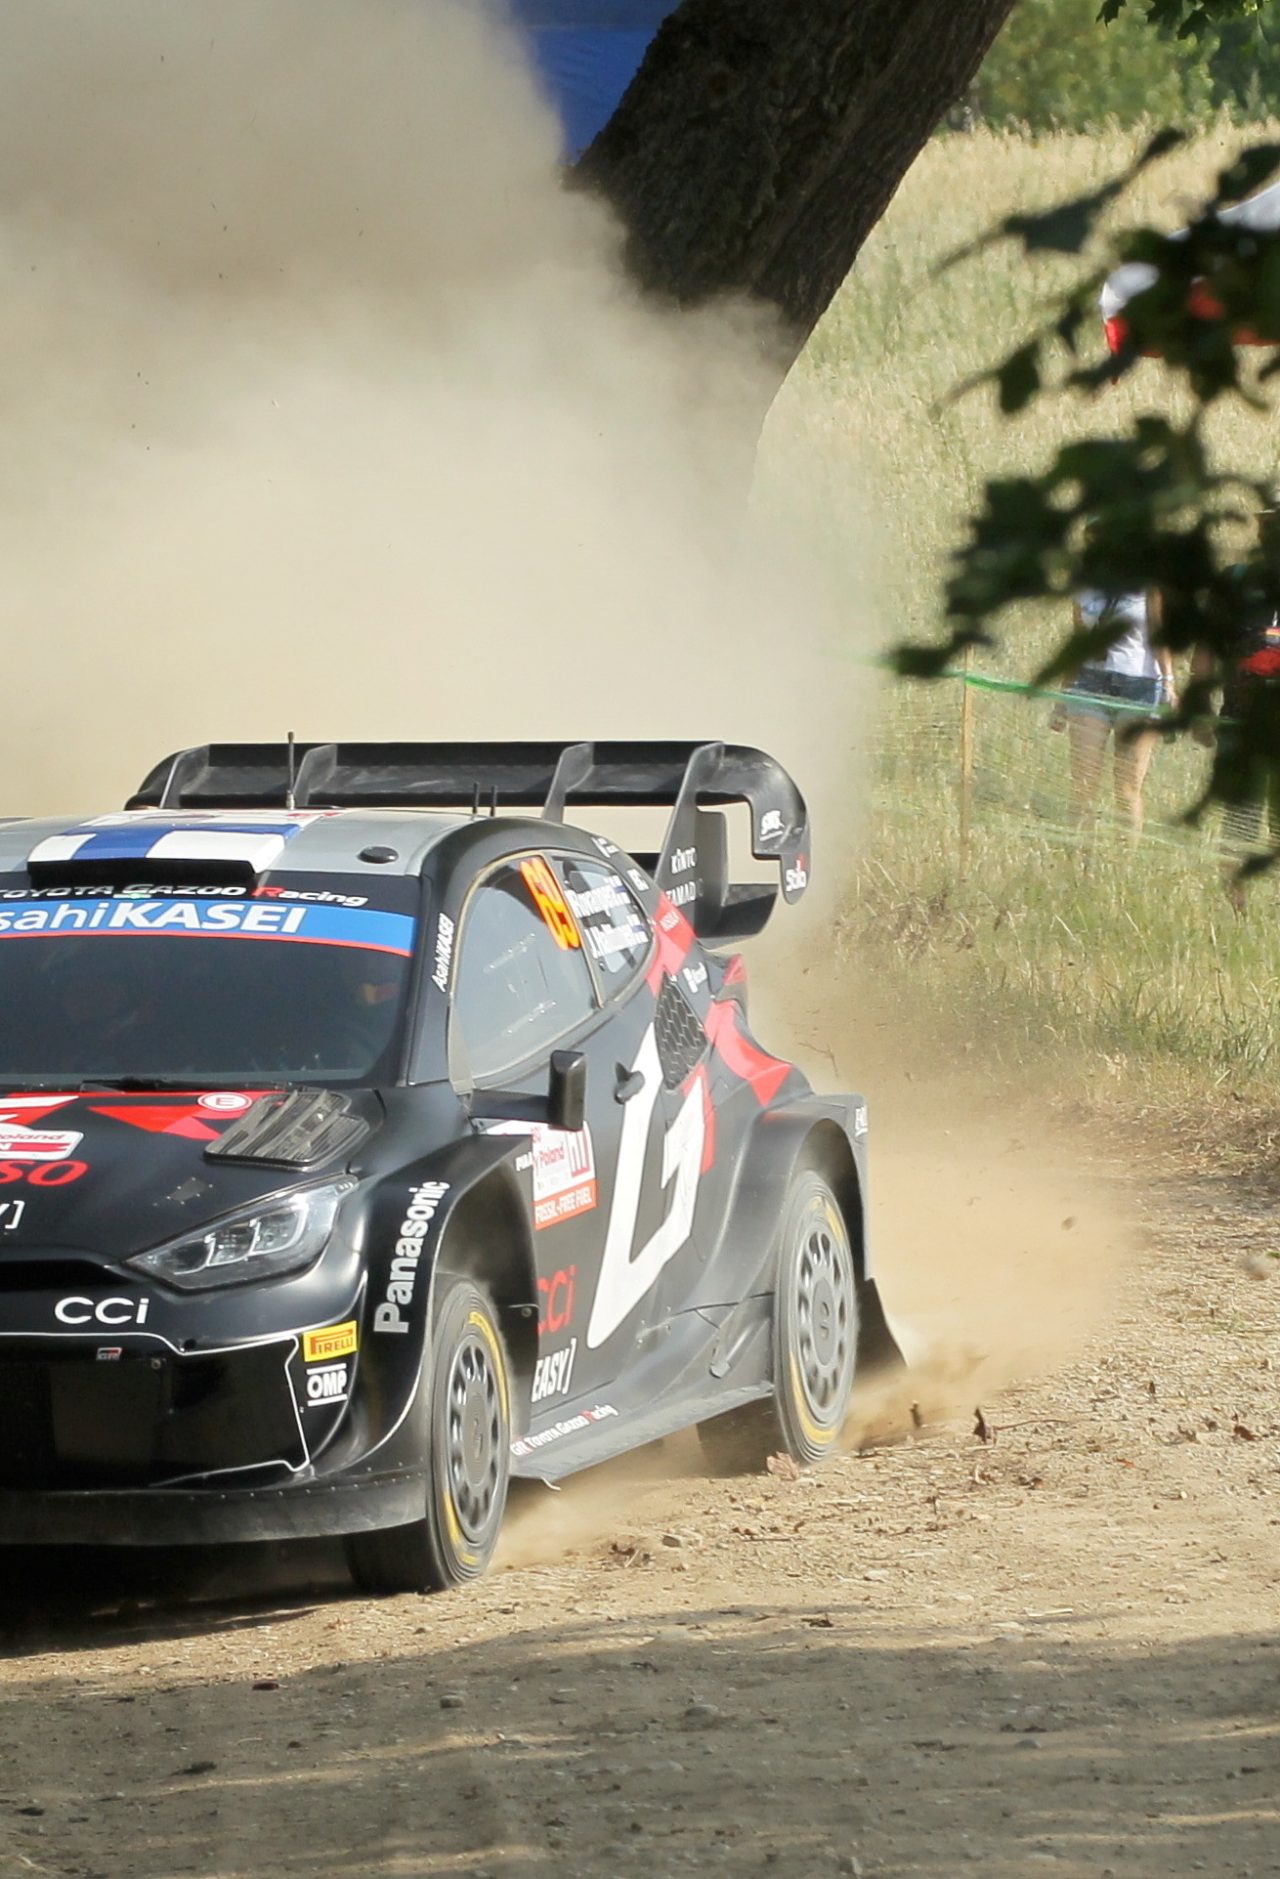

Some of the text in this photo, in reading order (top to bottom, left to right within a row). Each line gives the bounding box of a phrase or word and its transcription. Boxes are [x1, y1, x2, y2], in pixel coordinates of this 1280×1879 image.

[252, 886, 368, 907] Racing
[430, 912, 455, 993] AsahiKASEI
[373, 1180, 451, 1334] Panasonic
[310, 1328, 354, 1355] PIRELLI
[307, 1369, 348, 1399] OMP
